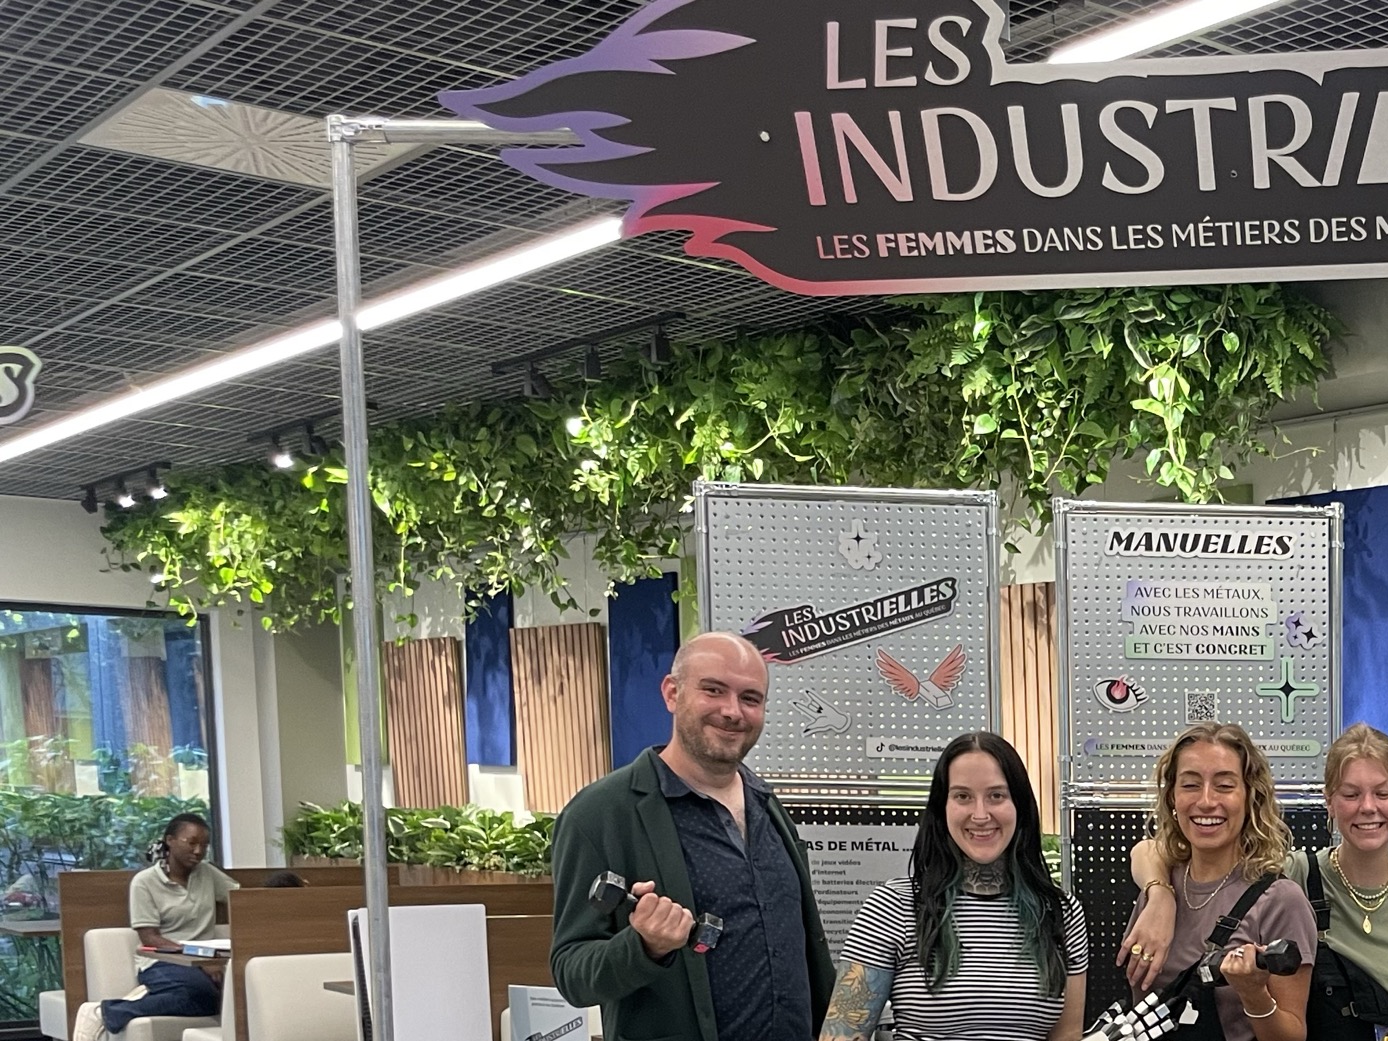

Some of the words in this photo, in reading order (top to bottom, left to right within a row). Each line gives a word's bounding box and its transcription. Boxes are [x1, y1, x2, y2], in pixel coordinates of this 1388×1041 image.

[826, 15, 972, 89] LES
[816, 233, 870, 260] LES
[877, 229, 1017, 258] FEMMES
[1023, 226, 1104, 252] DANS
[1111, 224, 1164, 250] LES
[1172, 216, 1300, 248] MÉTIERS
[1309, 217, 1367, 243] DES
[1109, 531, 1293, 555] MANUELLES
[1134, 587, 1171, 599] AVEC
[1175, 587, 1200, 599] LES
[1203, 585, 1265, 601] MÉTAUX,
[782, 580, 954, 648] INDUSTRIELLES
[785, 607, 813, 627] LES
[1130, 605, 1171, 617] NOUS
[1173, 606, 1269, 619] TRAVAILLONS
[1139, 624, 1176, 636] AVEC
[1179, 625, 1209, 637] NOS
[1212, 625, 1260, 637] MAINS
[1133, 642, 1150, 654] ET
[1153, 642, 1193, 654] C'EST
[1195, 643, 1267, 656] CONCRET
[1280, 744, 1311, 752] QUÉBEC
[805, 841, 824, 851] AS
[827, 841, 847, 851] DE
[851, 837, 899, 852] MÉTAL
